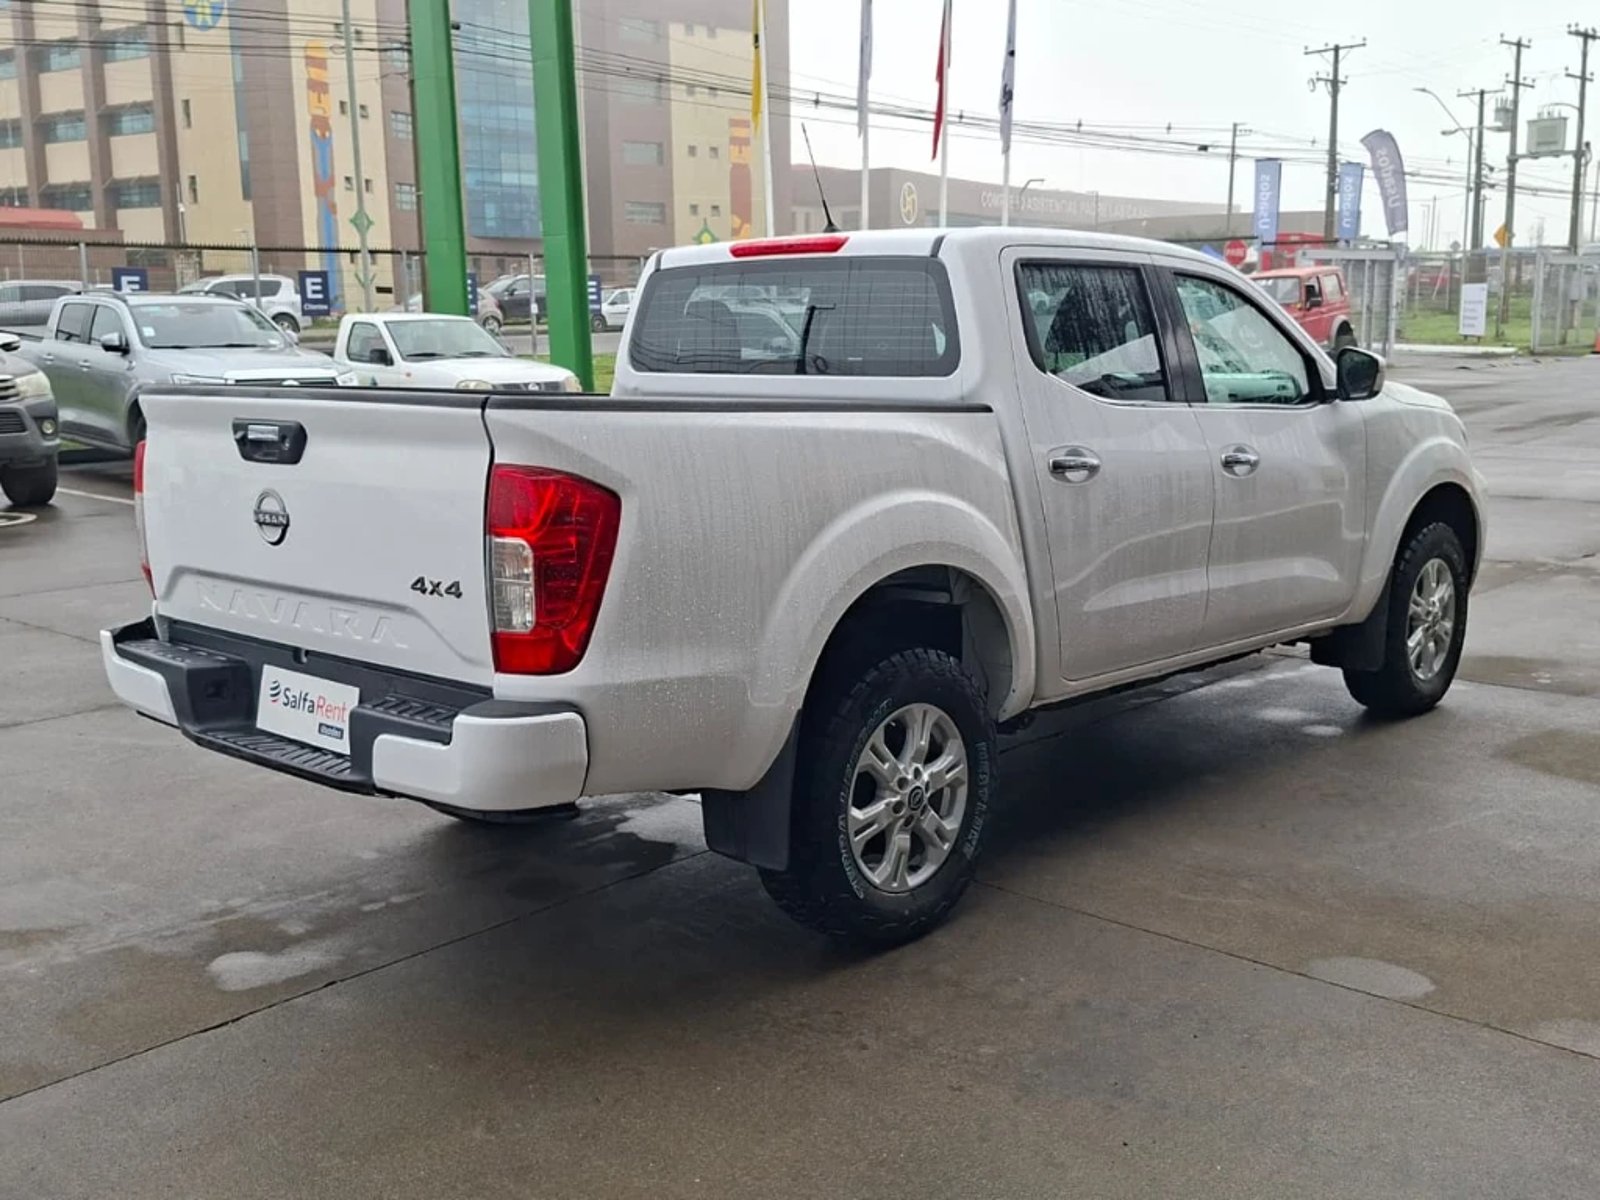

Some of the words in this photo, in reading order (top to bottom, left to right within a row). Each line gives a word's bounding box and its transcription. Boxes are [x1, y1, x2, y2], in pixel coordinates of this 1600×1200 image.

[305, 277, 324, 299] E
[410, 576, 463, 599] 4x4
[195, 580, 409, 648] NAVARA
[282, 687, 347, 723] SalfaRent
